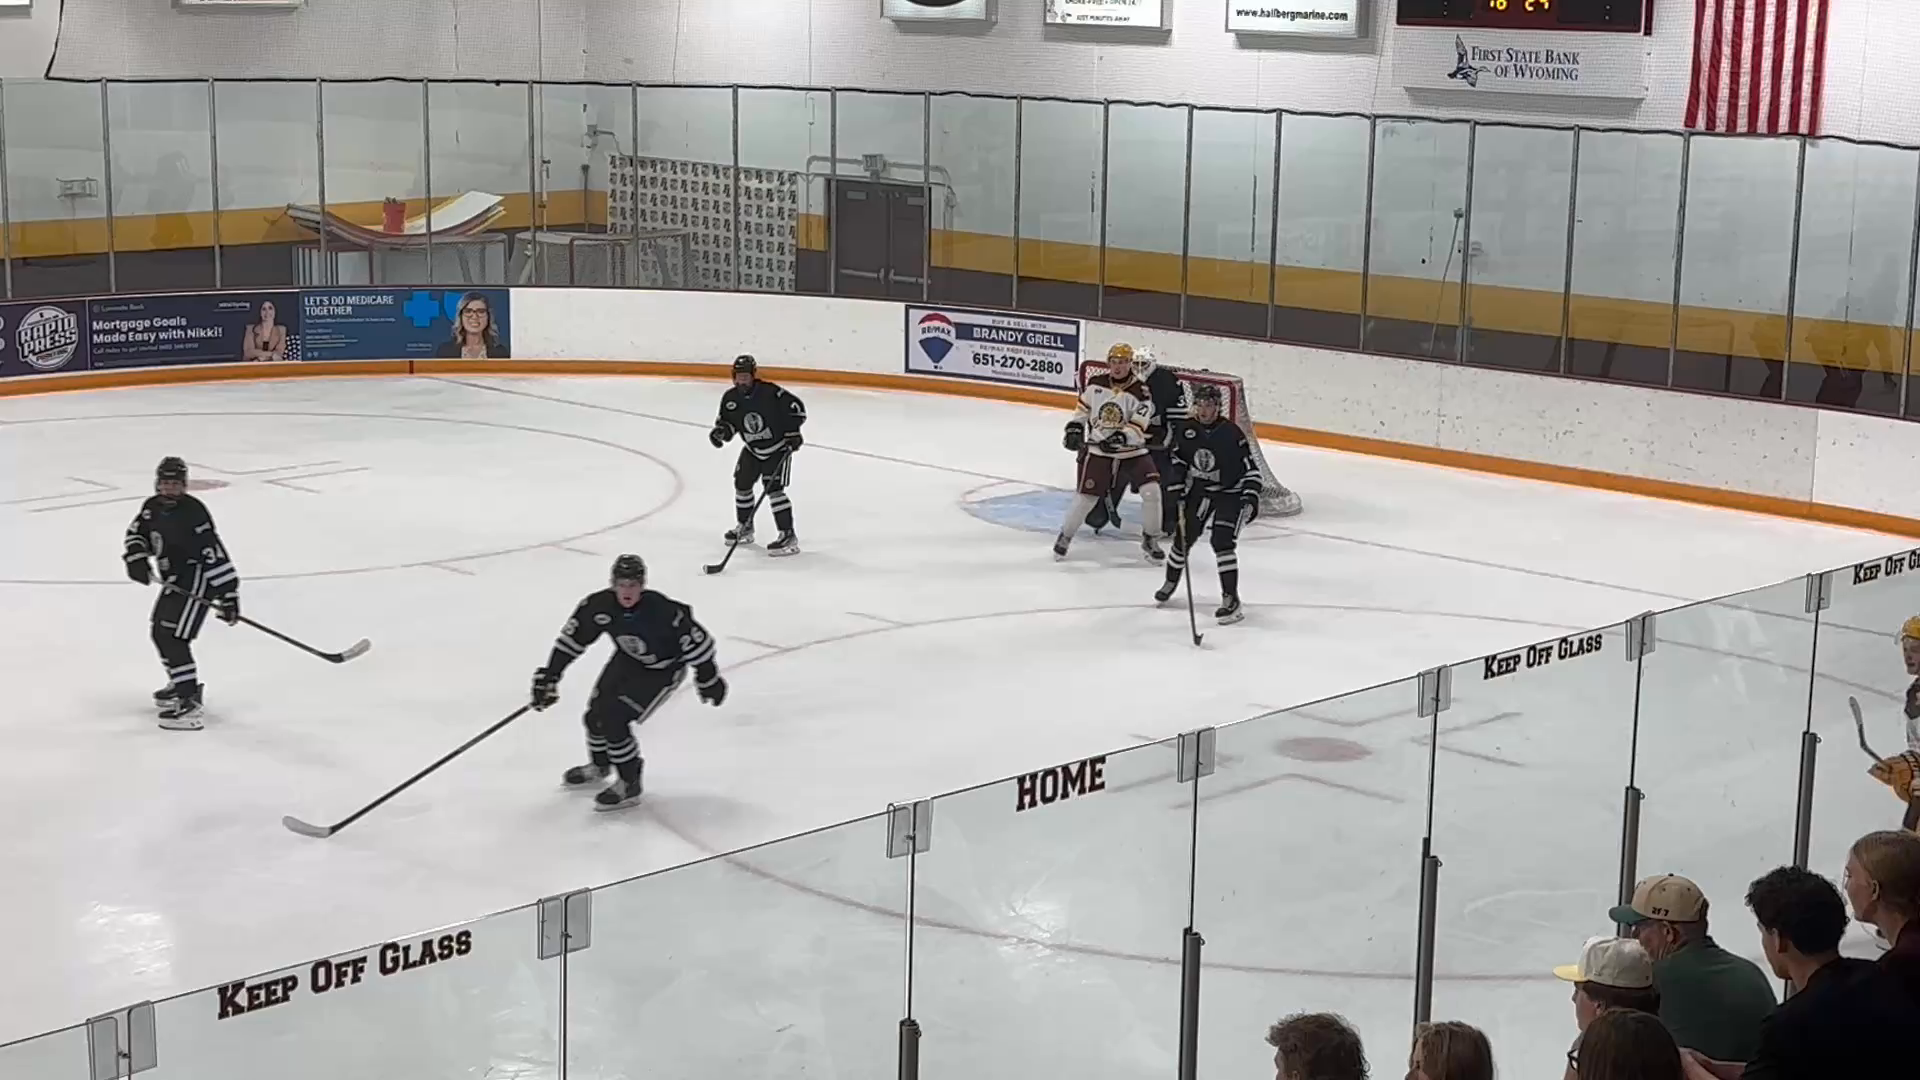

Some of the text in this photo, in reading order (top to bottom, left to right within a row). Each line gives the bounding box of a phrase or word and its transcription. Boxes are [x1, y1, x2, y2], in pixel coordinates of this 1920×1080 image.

[1236, 8, 1348, 21] www.hallbergmarine.com
[1472, 46, 1580, 66] FIRST STATE BANK
[1494, 63, 1579, 81] OF WYOMING
[305, 306, 353, 316] TOGETHER
[331, 296, 344, 306] DO
[346, 295, 395, 305] MEDICARE
[20, 316, 74, 344] RAPID
[92, 316, 187, 331] Mortgage Goals
[23, 330, 76, 357] PRESS
[93, 326, 223, 344] Made Easy with Nikki!
[973, 327, 1065, 348] BRANDY GRELL
[972, 352, 1064, 375] 651-270-2880
[679, 626, 706, 652] 26
[1483, 633, 1603, 681] KEEP OFF GLASS
[1016, 755, 1107, 813] HOME
[217, 929, 473, 1020] KEEP OFF GLASS
